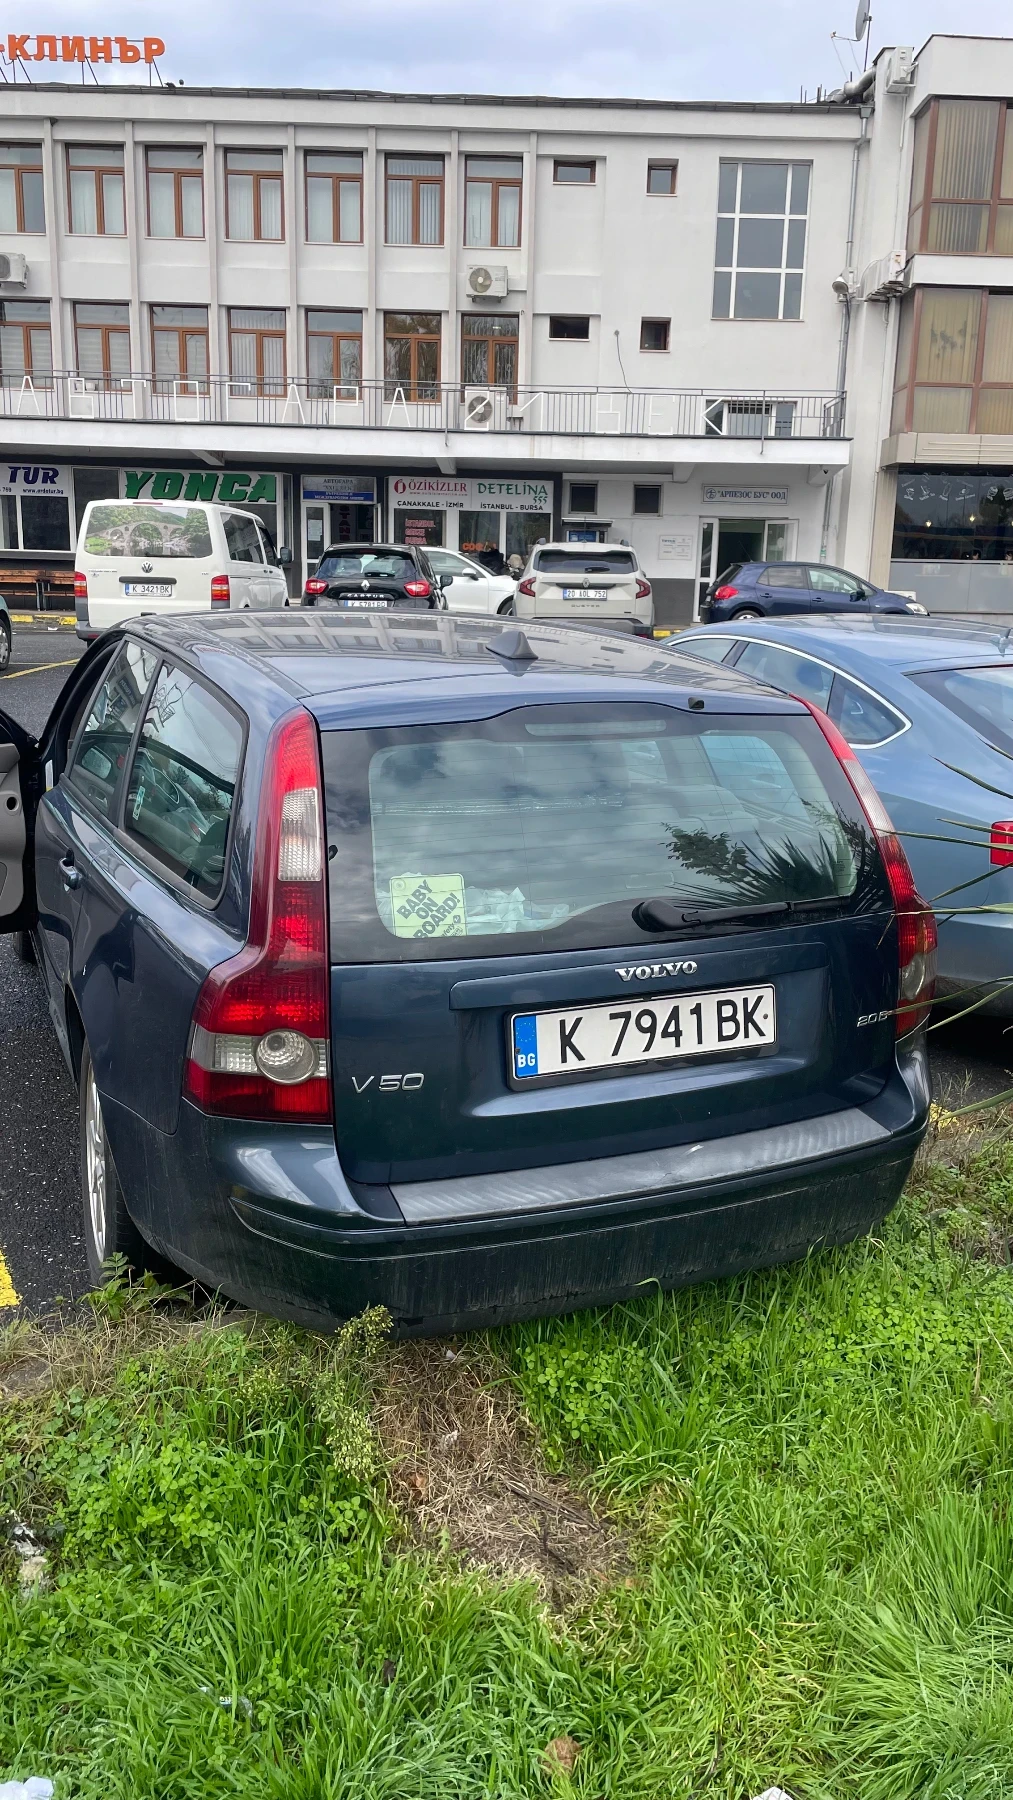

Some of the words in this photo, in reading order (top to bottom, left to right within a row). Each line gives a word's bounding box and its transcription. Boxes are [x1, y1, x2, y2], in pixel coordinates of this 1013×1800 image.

[8, 466, 60, 485] TUR
[124, 471, 277, 503] YONCA
[408, 479, 467, 492] ÖZİKİZLER
[477, 482, 548, 496] DETELİNA
[770, 491, 786, 500] ООД
[397, 500, 440, 508] ÇANAKKALE
[480, 502, 514, 510] İSTANBUL
[132, 585, 138, 593] K
[567, 590, 576, 598] 20
[594, 590, 606, 598] 752
[396, 879, 433, 920] BABY
[412, 892, 461, 939] BOARD!
[415, 896, 440, 920] ON
[615, 960, 698, 983] VOLVO
[558, 1016, 586, 1064] K
[517, 1053, 536, 1068] BG
